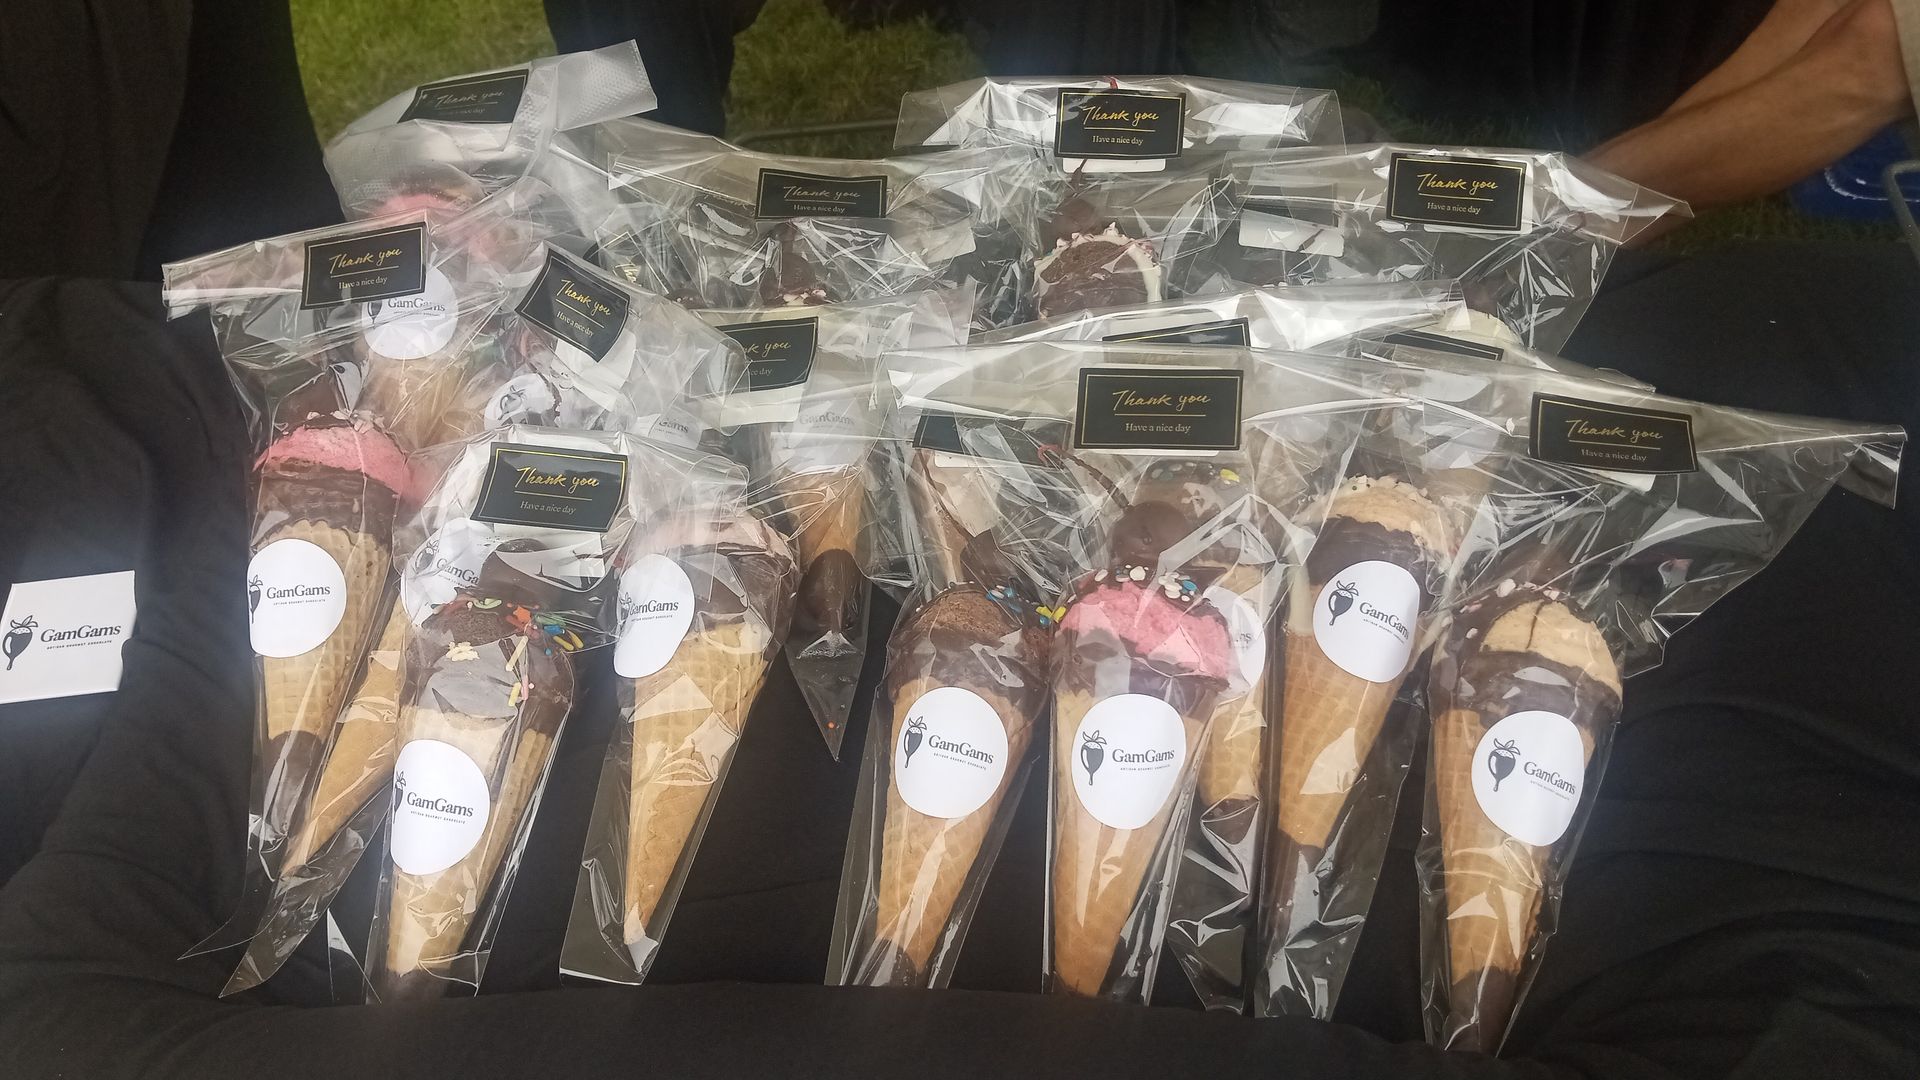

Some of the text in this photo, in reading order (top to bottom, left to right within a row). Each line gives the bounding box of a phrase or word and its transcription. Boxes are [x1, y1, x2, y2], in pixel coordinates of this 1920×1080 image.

[434, 93, 478, 108] Thank
[1080, 105, 1160, 127] Thank you
[1092, 135, 1111, 143] Have
[1116, 136, 1131, 144] nice
[1131, 136, 1144, 147] day
[1416, 173, 1498, 195] Thank you
[783, 185, 861, 200] Thank you
[832, 205, 846, 214] day
[1427, 202, 1446, 211] Have
[1452, 204, 1467, 213] nice
[1467, 204, 1481, 215] day
[329, 247, 402, 275] Thank you
[338, 280, 355, 290] Have
[361, 277, 375, 286] nice
[375, 275, 388, 286] day
[556, 279, 611, 317] Thank you
[761, 342, 791, 358] you
[1112, 389, 1211, 412] Thank you
[1125, 423, 1148, 432] Have
[1155, 423, 1174, 432] nice
[1174, 423, 1192, 434] day
[1565, 419, 1663, 444] Thank you
[1581, 448, 1604, 458] Have
[1611, 451, 1630, 461] nice
[1630, 452, 1647, 462] day
[514, 466, 600, 494] Thank you
[520, 500, 540, 510] Have
[545, 503, 562, 513] nice
[561, 504, 577, 516] day
[266, 584, 331, 600] GamGams
[41, 624, 122, 643] GamGams
[928, 734, 994, 764] GamGams
[1111, 748, 1175, 763] GamGams
[1523, 761, 1576, 795] GamGams
[406, 791, 474, 818] GamGams
